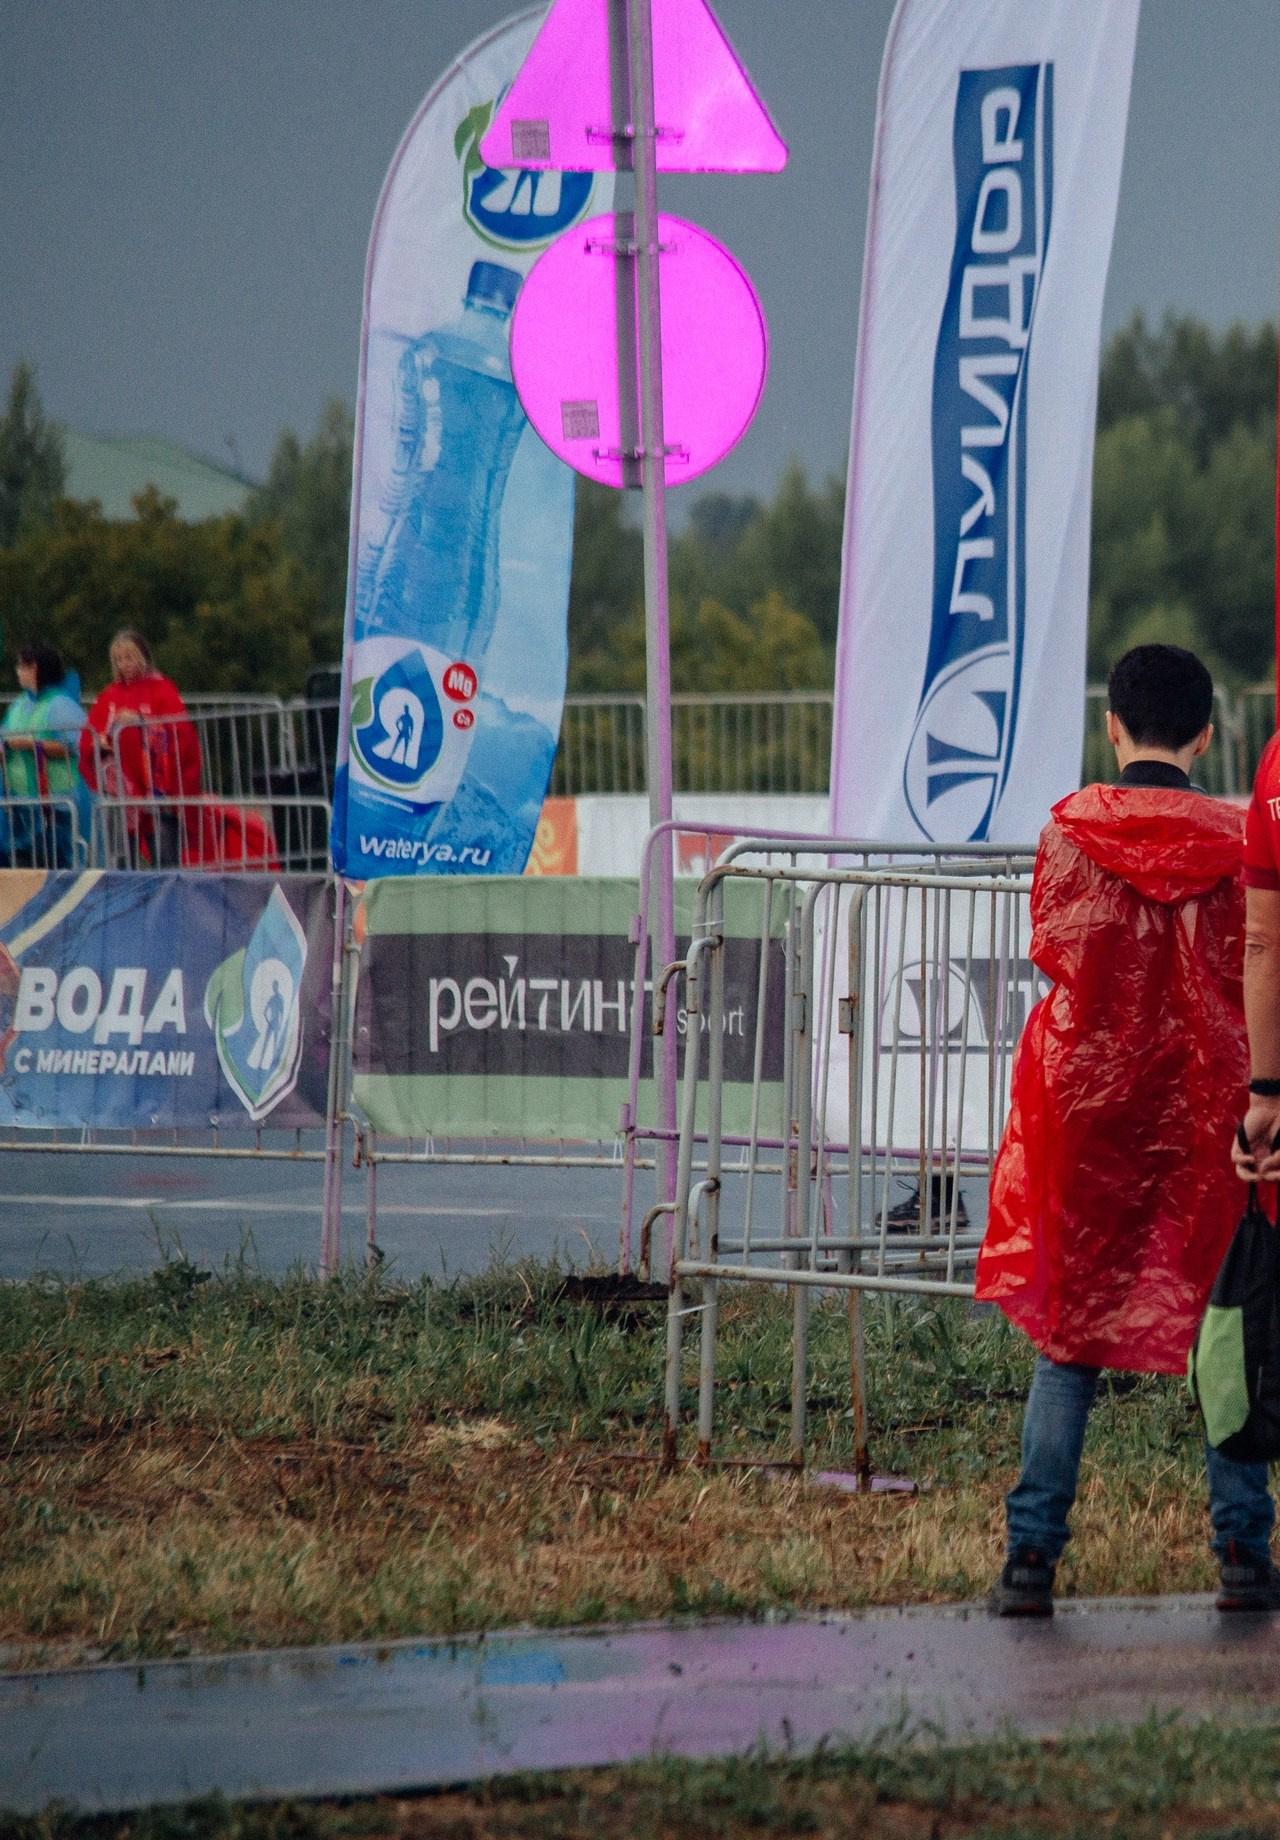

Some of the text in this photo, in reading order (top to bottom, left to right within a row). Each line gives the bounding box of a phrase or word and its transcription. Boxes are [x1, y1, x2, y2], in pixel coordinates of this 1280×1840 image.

[448, 670, 473, 698] Mg
[359, 835, 491, 867] waterya.ru
[13, 966, 187, 1045] ВОДА
[429, 955, 652, 1052] рейтин
[14, 1049, 195, 1076] С МИНЕРАЛАМИ
